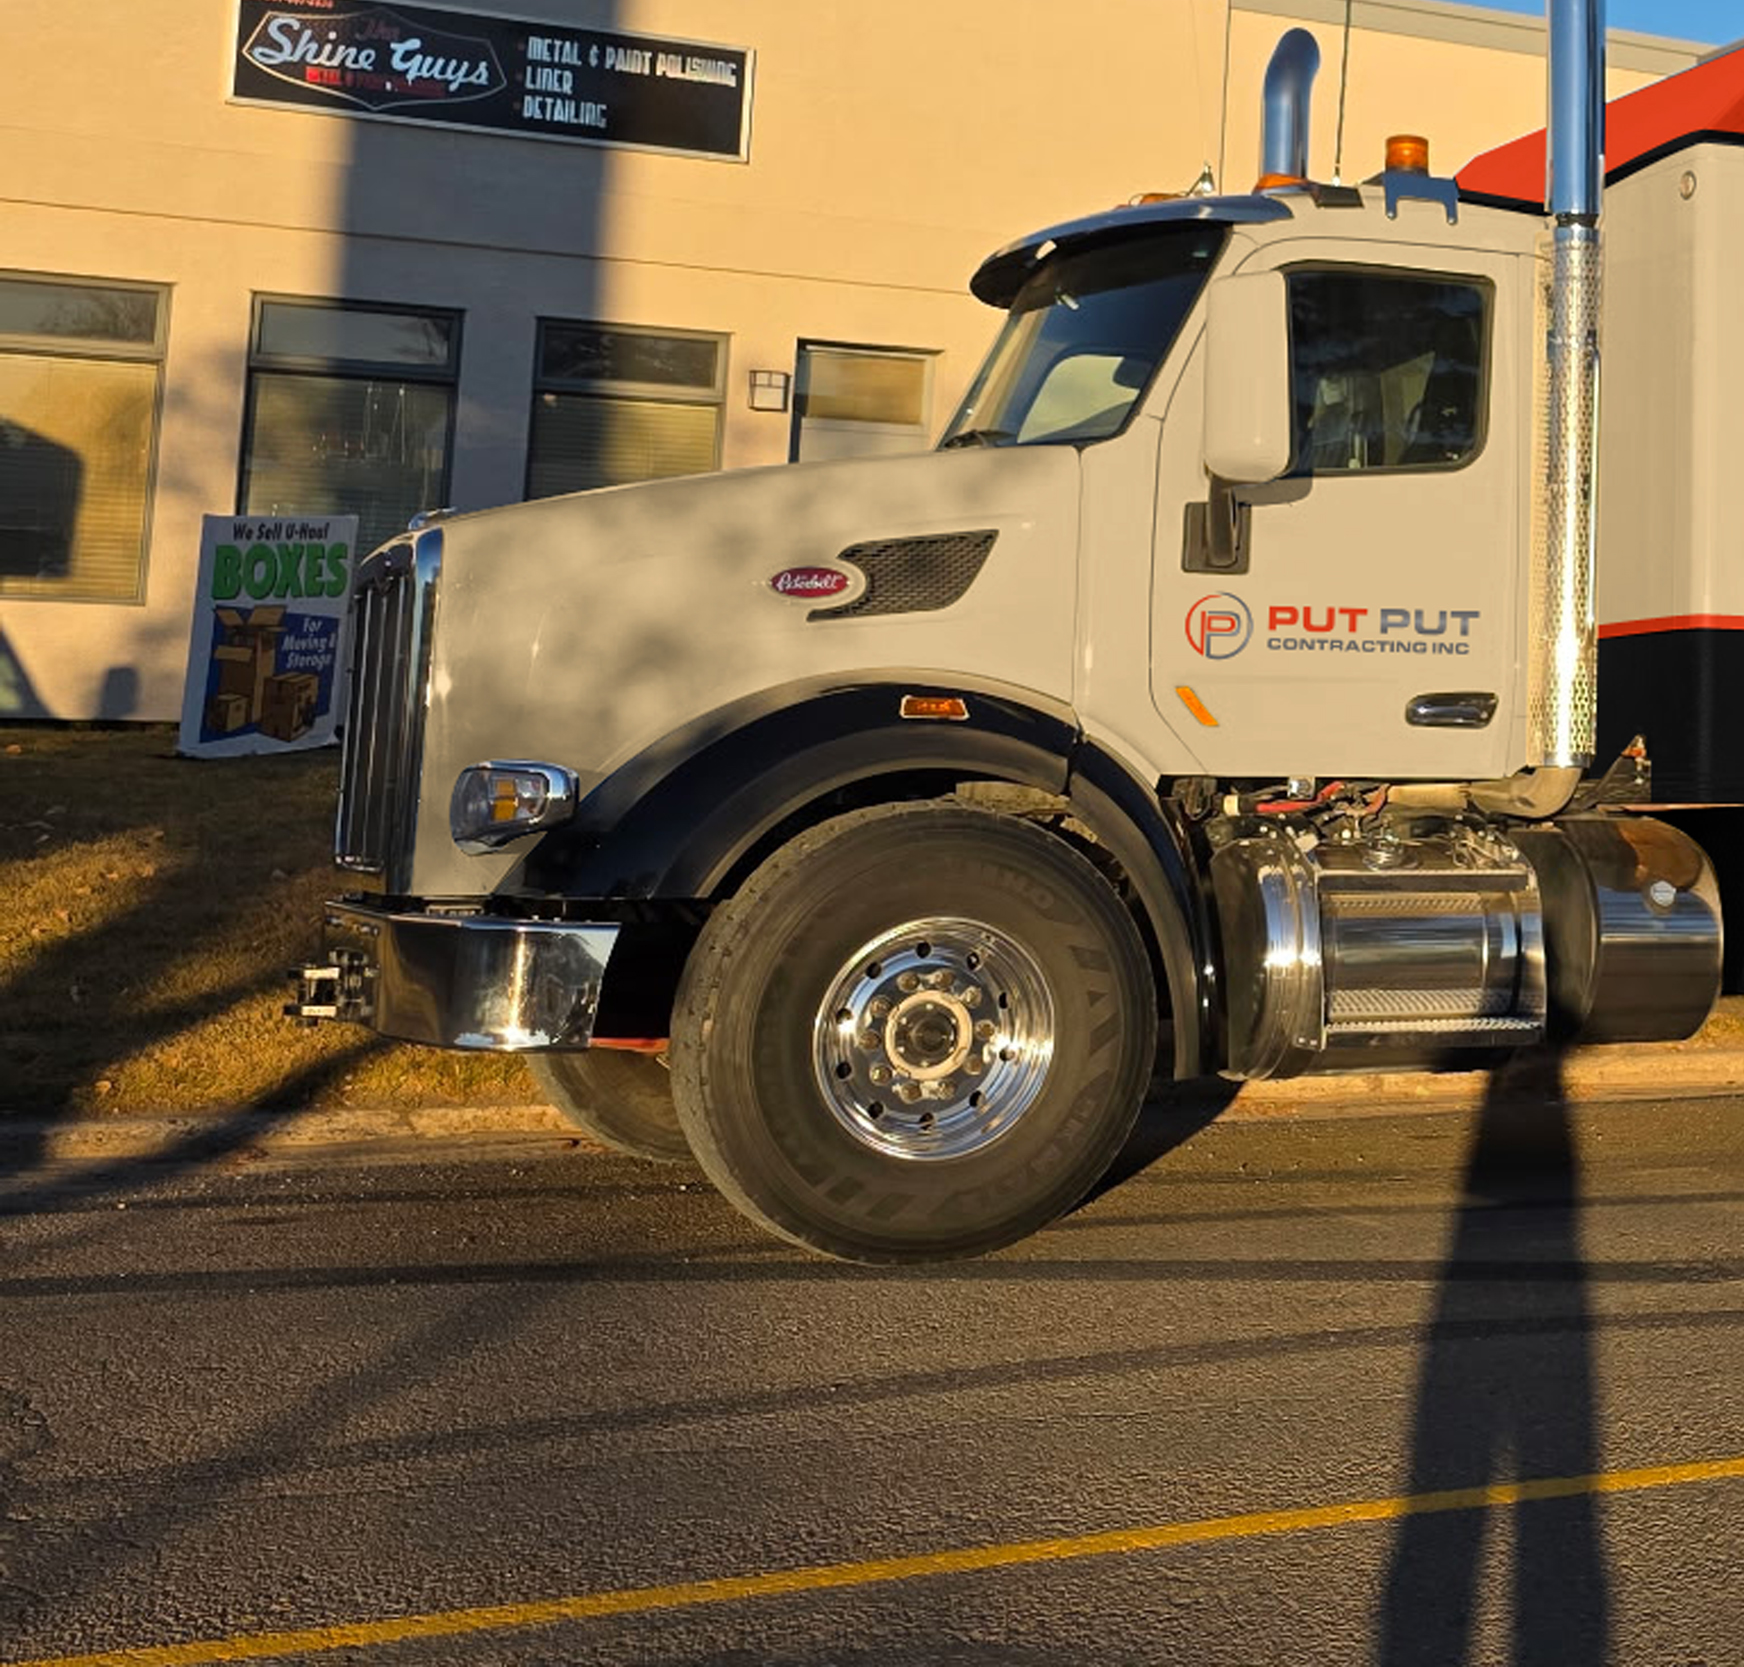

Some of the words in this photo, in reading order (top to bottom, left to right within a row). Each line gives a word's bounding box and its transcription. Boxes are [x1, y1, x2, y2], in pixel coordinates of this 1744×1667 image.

[252, 17, 376, 71] Shine
[389, 38, 490, 92] Guys
[527, 35, 582, 67] METAL
[605, 46, 653, 76] PAINT
[656, 52, 737, 88] POLISHING
[524, 65, 573, 95] LINER
[522, 94, 607, 129] DETAILING
[233, 522, 254, 541] We
[256, 522, 282, 541] Sell
[211, 542, 349, 601] BOXES
[1268, 606, 1368, 633] PUT
[1380, 608, 1480, 636] PUT
[1266, 638, 1427, 654] CONTRACTING
[1432, 641, 1470, 655] INC
